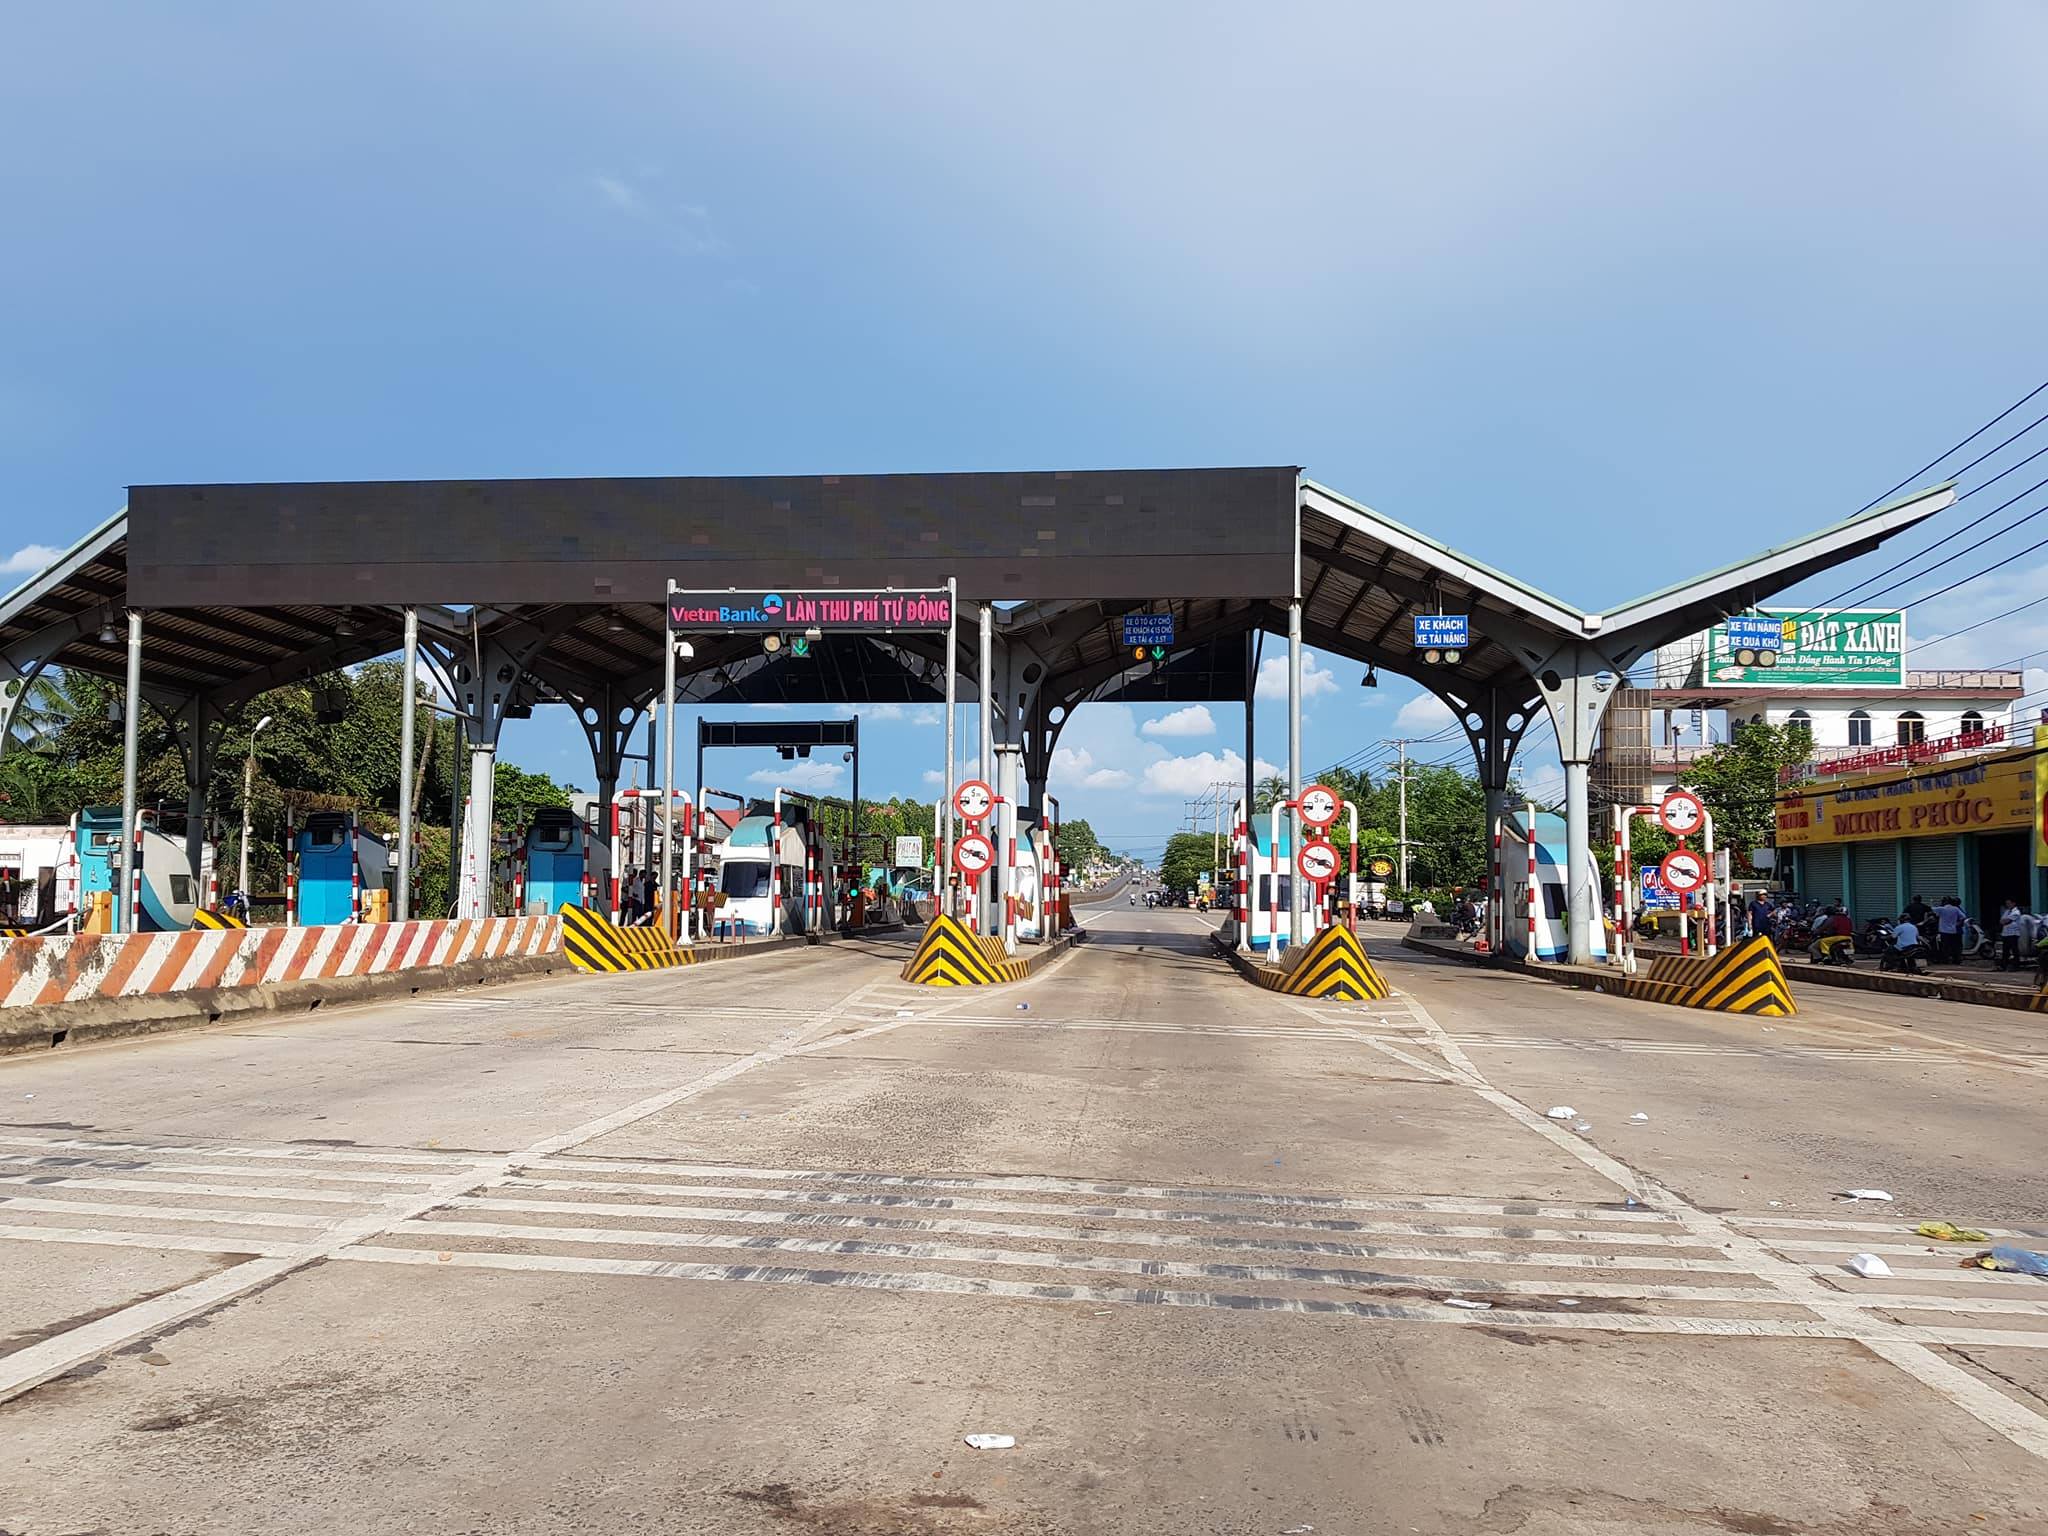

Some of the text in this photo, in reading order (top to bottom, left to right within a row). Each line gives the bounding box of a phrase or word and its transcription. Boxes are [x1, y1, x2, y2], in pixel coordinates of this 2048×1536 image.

[671, 606, 761, 622] VietinBank
[786, 594, 949, 626] LÀN THU PHÍ TỰ ĐỘNG
[1419, 617, 1463, 630] XE KHÁCH
[1730, 618, 1780, 635] XE TẢI NẶNG
[1801, 610, 1840, 652] ĐẤT
[1843, 621, 1900, 653] XANH
[1417, 630, 1466, 646] XE TẢI NẶNG
[1730, 636, 1742, 646] XE
[1743, 634, 1760, 647] QUÁ
[1135, 646, 1143, 660] 6
[1832, 807, 1902, 836] MINH
[1908, 788, 1994, 829] PHÚC
